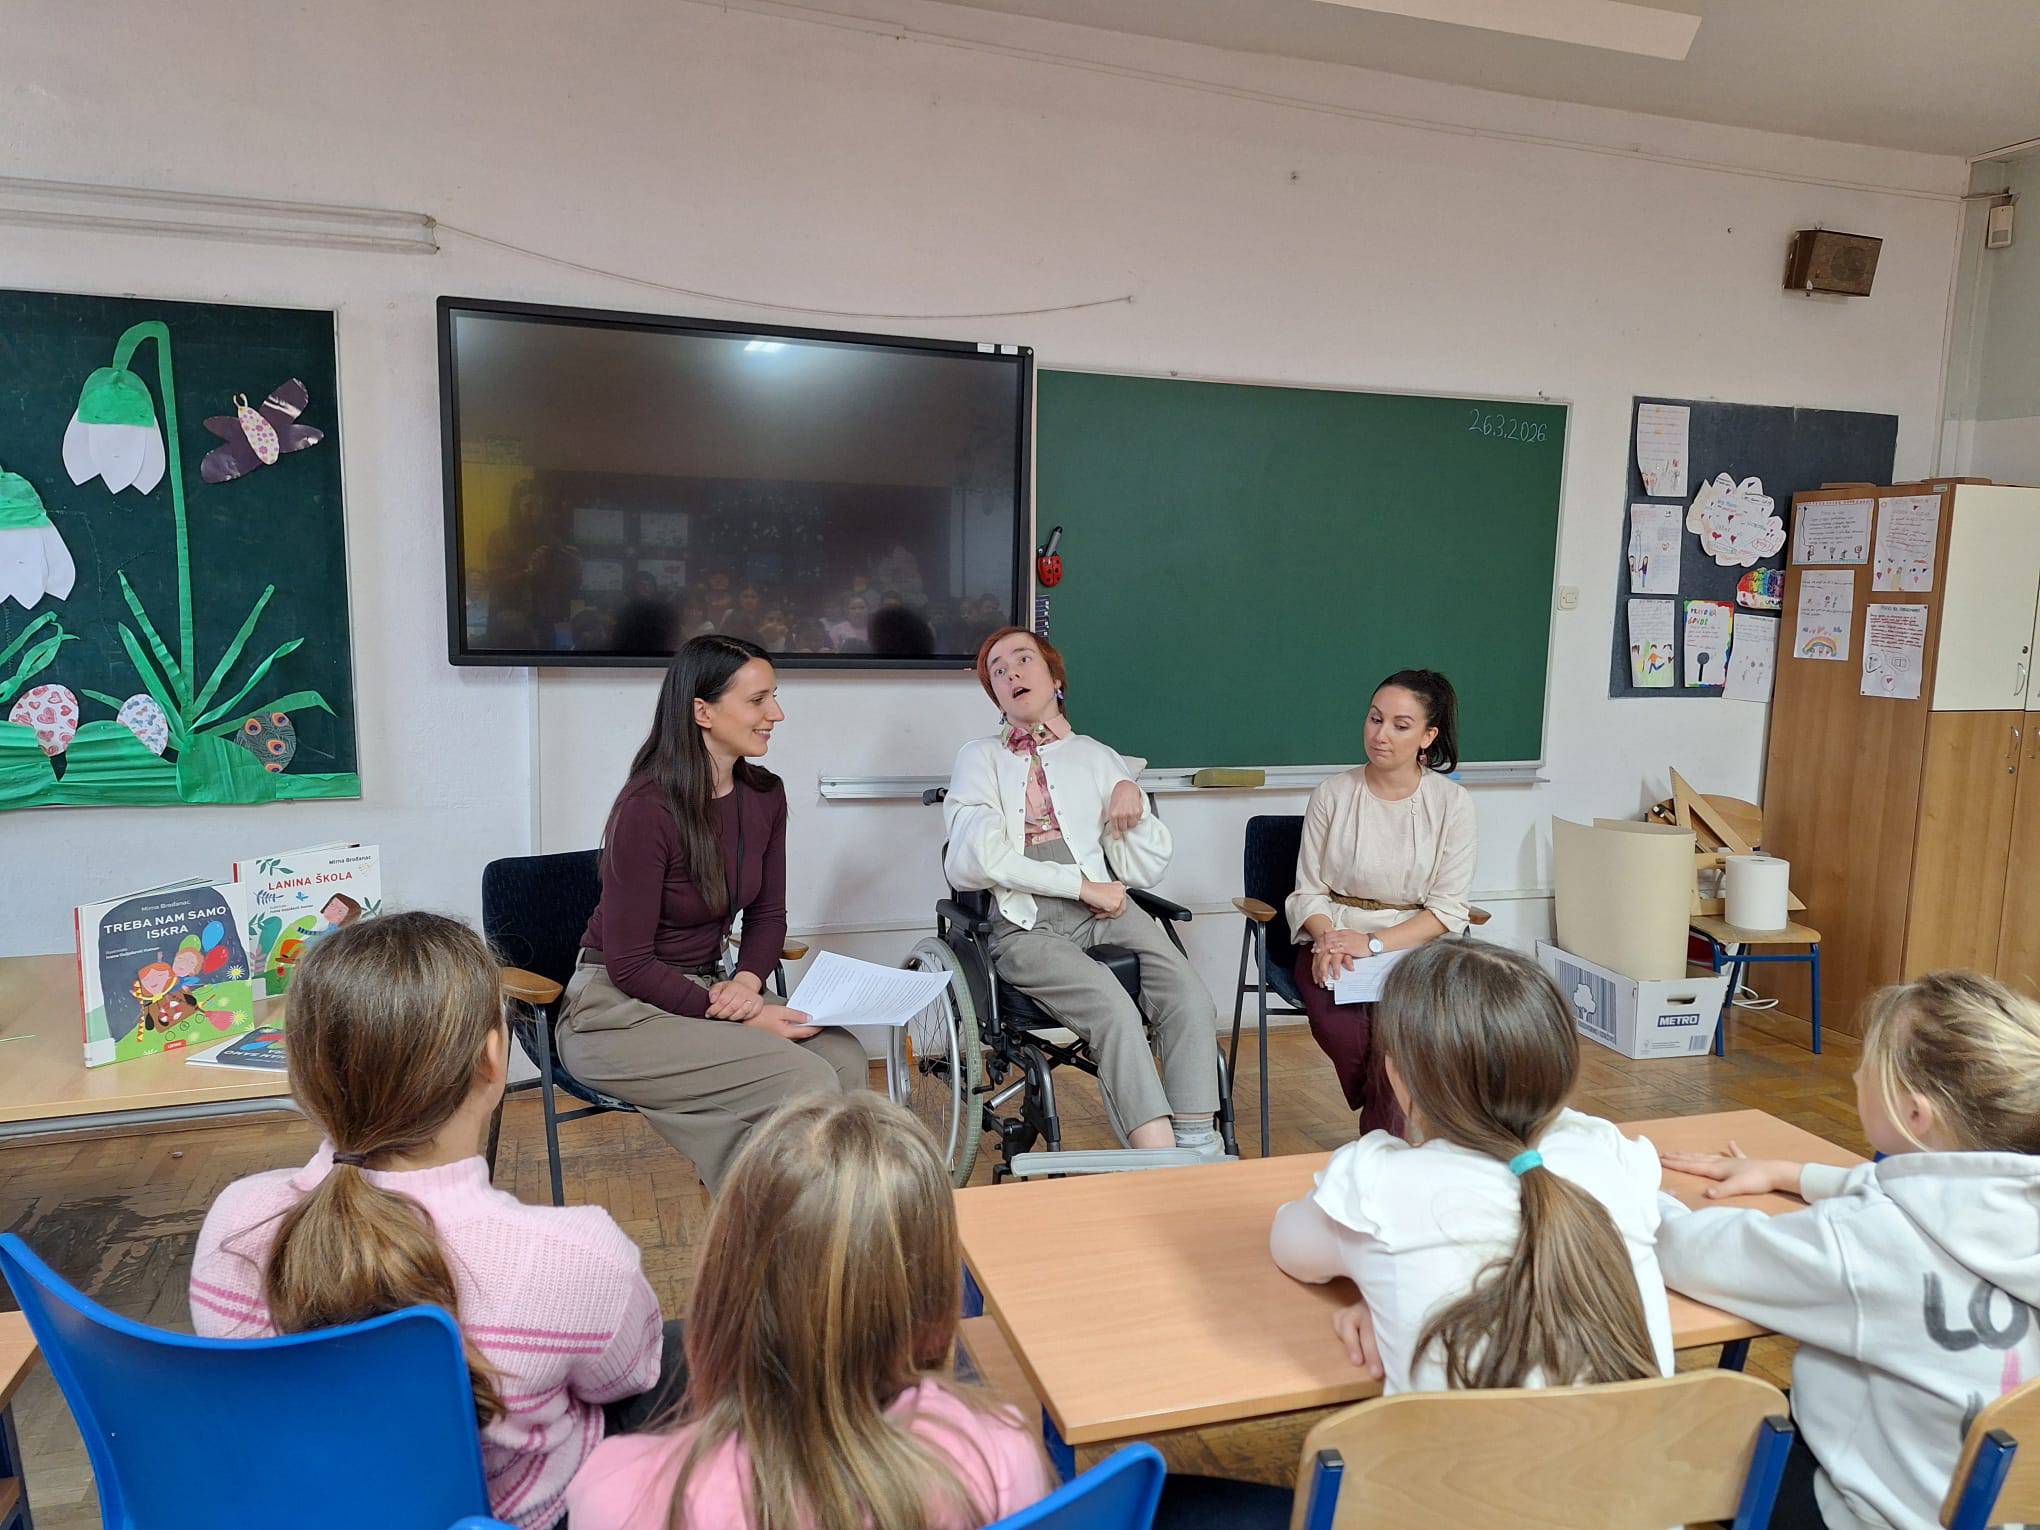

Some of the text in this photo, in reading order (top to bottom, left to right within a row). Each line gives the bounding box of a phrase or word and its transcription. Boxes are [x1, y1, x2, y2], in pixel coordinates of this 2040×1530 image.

[1468, 408, 1547, 442] 26.3.2026
[268, 871, 353, 891] LANINA ŠKOLA
[103, 906, 227, 934] TREBA NAM SAMO
[146, 924, 189, 940] ISKRA
[1659, 1015, 1698, 1026] METRO
